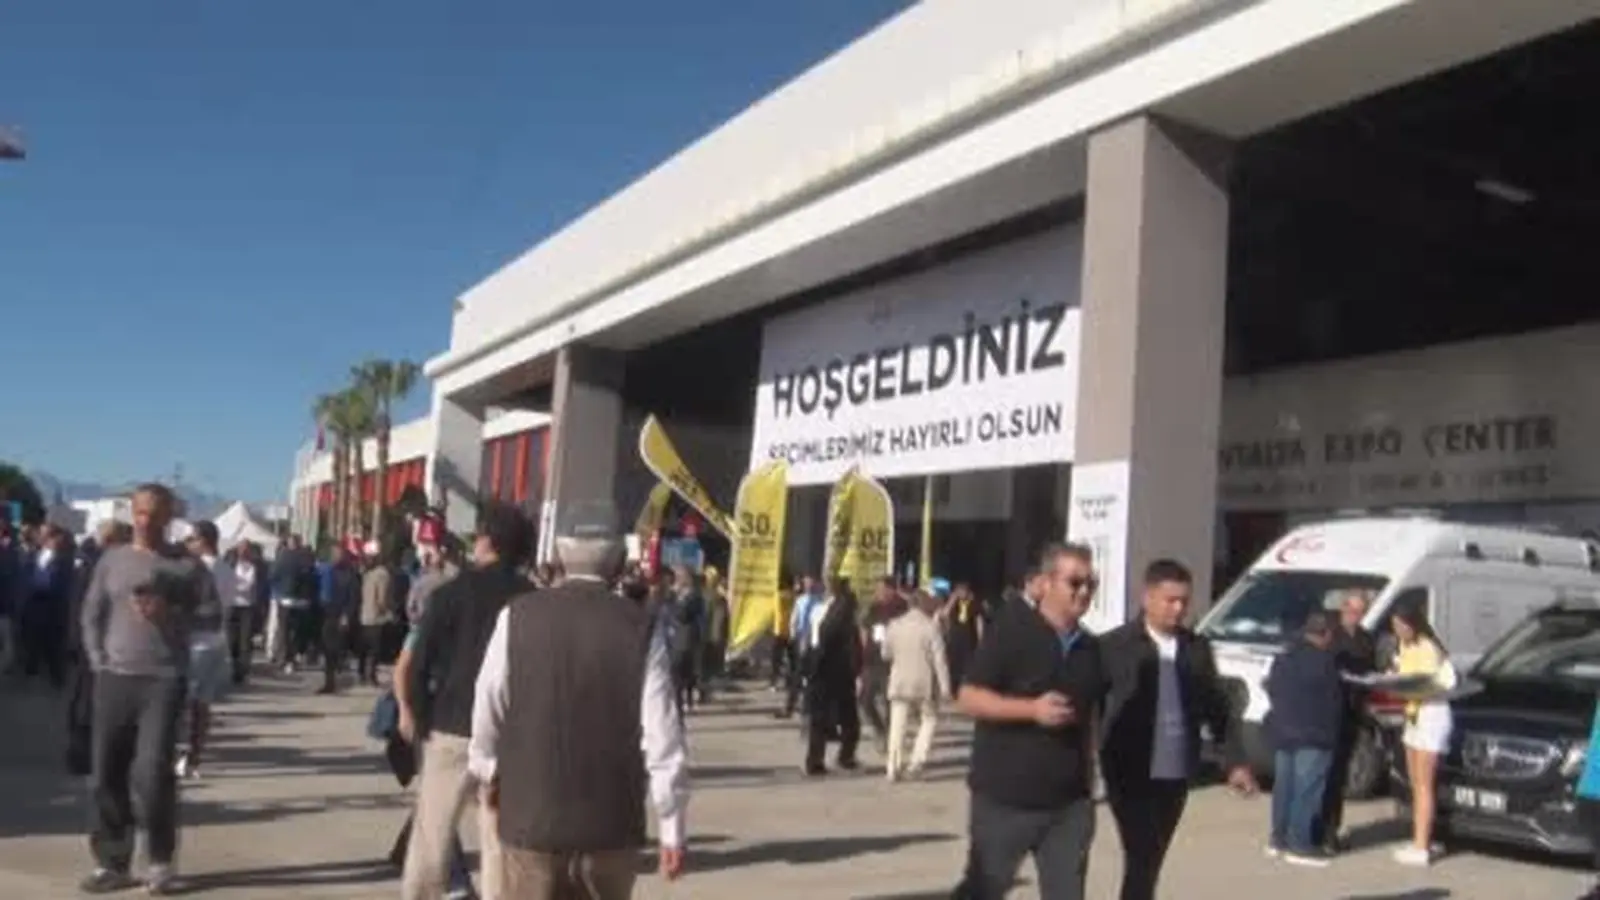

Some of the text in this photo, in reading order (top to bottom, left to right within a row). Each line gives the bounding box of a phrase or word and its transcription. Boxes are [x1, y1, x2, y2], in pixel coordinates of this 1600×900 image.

[773, 297, 1066, 420] HOŞGELDİNİZ
[889, 415, 973, 453] HAYIRLI
[977, 402, 1063, 443] OLSUN
